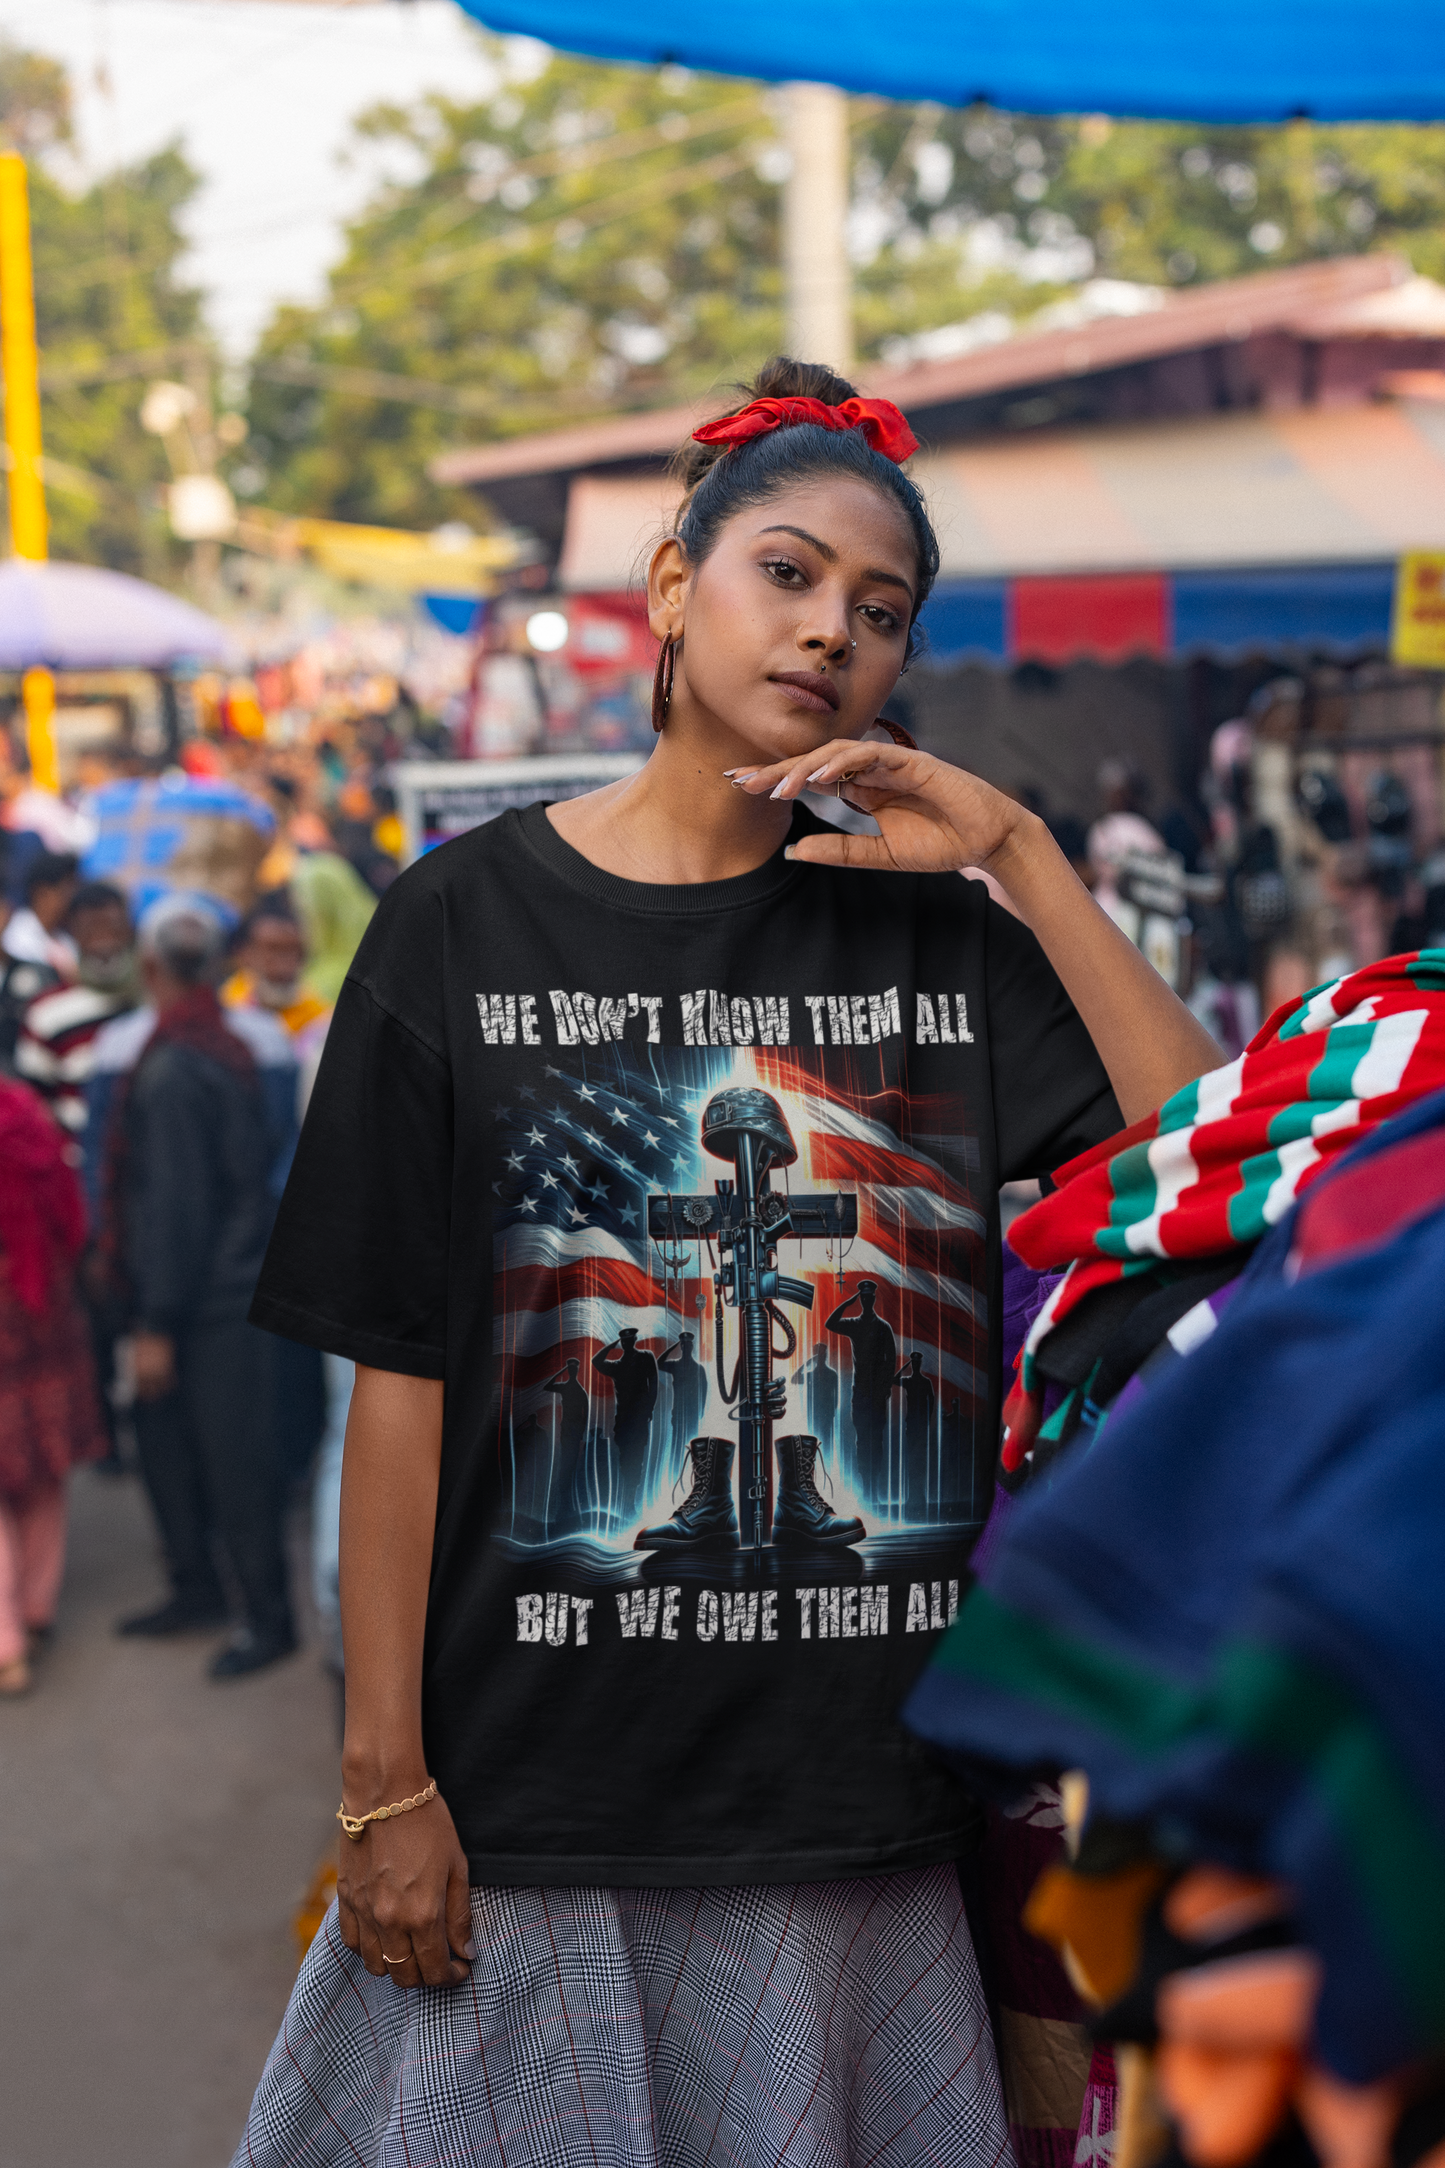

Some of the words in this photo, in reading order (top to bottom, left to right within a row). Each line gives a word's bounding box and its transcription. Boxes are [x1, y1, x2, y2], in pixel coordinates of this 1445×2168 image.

[475, 993, 542, 1045] WE
[679, 989, 790, 1046] KNOW
[804, 985, 902, 1045] THEM
[915, 992, 975, 1045] ALL
[515, 1591, 594, 1647] BUT
[615, 1585, 682, 1640] WE
[696, 1589, 779, 1642] OWE
[795, 1584, 889, 1639] THEM
